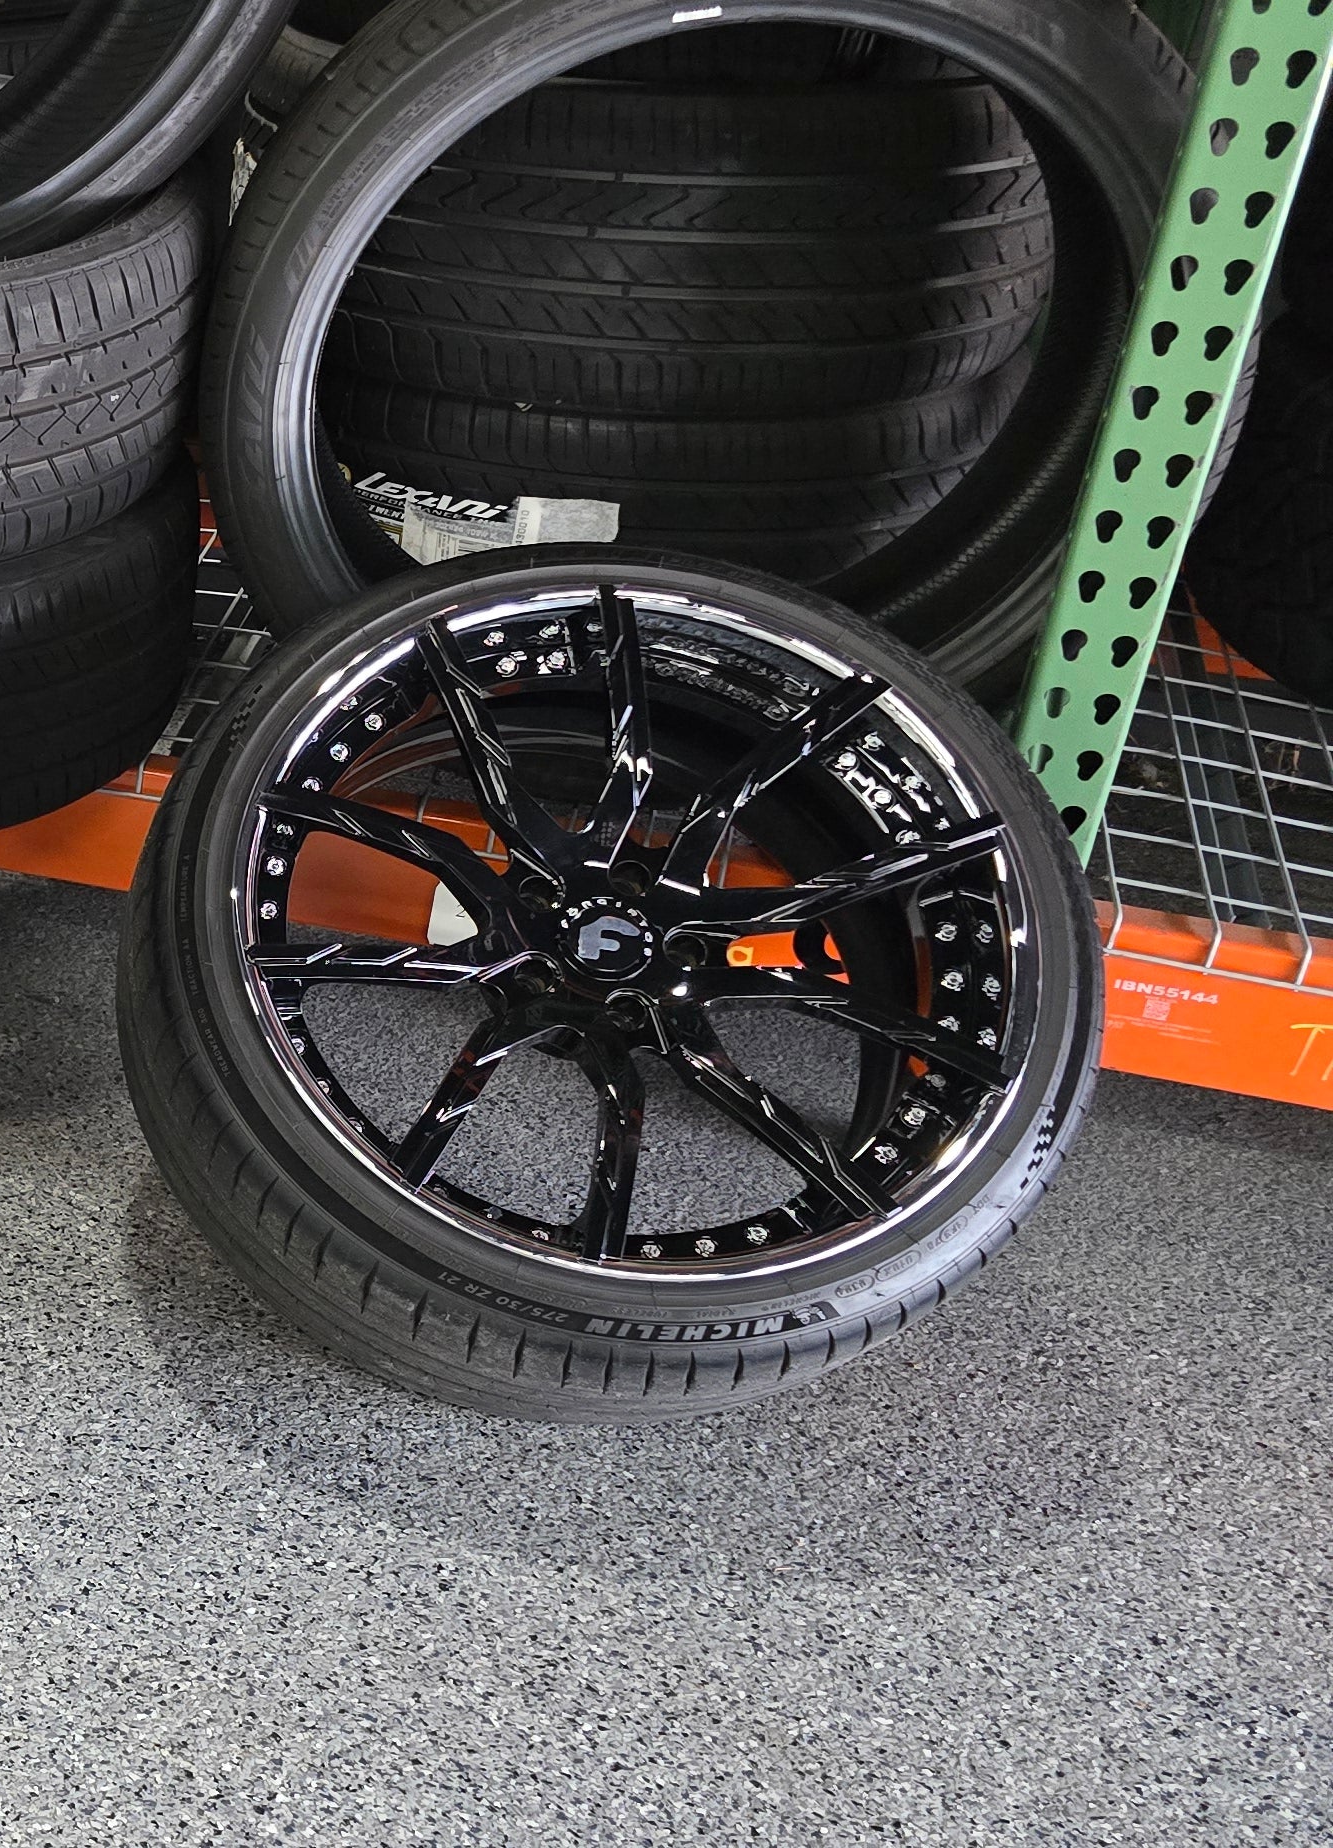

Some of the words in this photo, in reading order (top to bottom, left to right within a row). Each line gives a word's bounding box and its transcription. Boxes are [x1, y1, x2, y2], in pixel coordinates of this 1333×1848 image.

[181, 865, 191, 922] TEMPERATURE
[182, 938, 190, 949] AA
[185, 954, 200, 995] TRACTION
[1113, 977, 1219, 1005] IBN55144
[204, 1029, 231, 1077] TREADWEAR
[438, 1270, 462, 1289] 21
[462, 1281, 492, 1300] ZR
[497, 1295, 569, 1324] 275/30
[583, 1315, 785, 1342] MICHELIN
